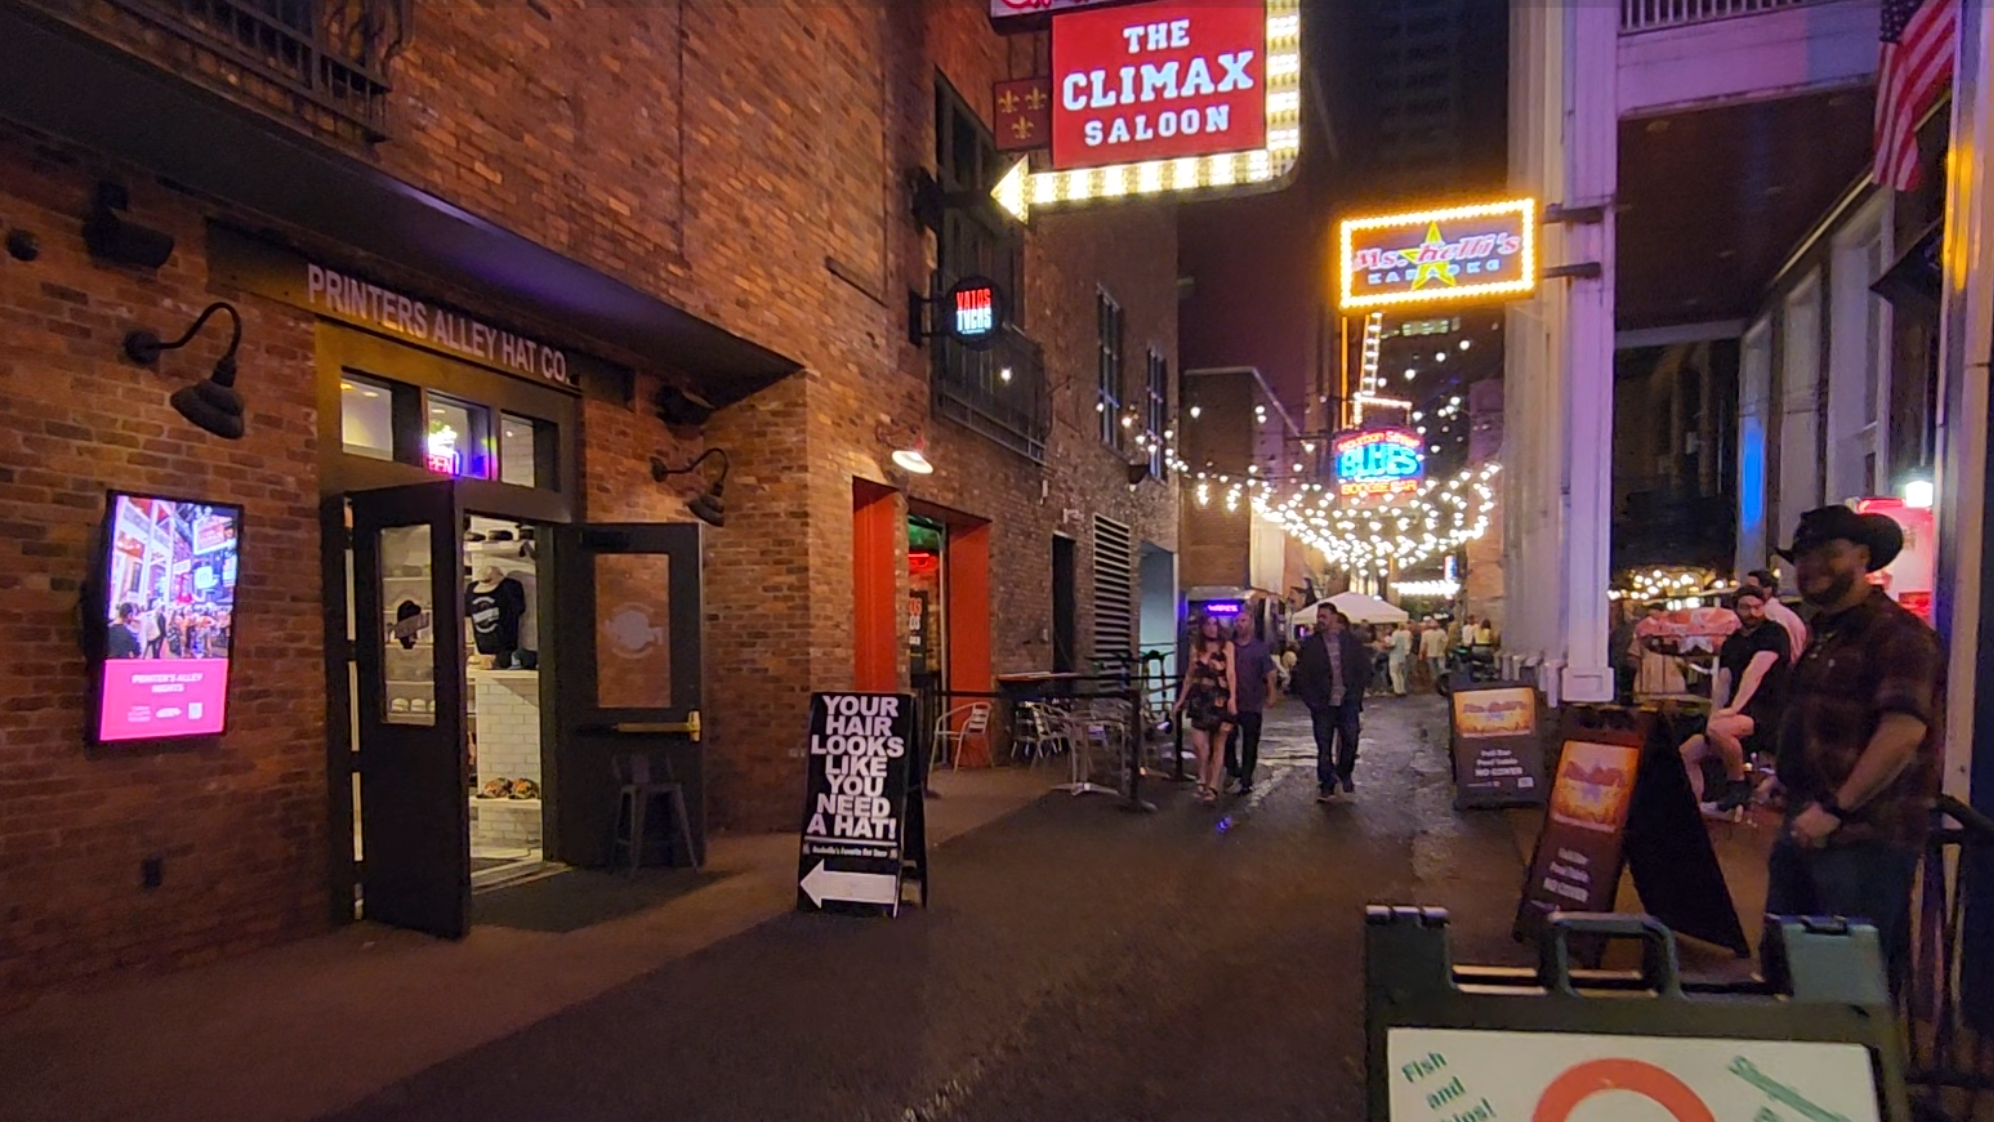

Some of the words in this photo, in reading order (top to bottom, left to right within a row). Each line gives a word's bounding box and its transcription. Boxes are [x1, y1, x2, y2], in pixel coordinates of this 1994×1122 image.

[1123, 19, 1190, 53] THE
[1063, 50, 1254, 111] CLIMAX
[1084, 104, 1229, 146] SALOON
[1367, 259, 1500, 285] KARAOKE
[308, 263, 428, 339] PRINTERS
[433, 308, 498, 361] ALLEY
[502, 331, 537, 373] HAT
[541, 346, 571, 386] CO.
[1340, 442, 1417, 477] BLUES
[822, 695, 899, 717] YOUR
[825, 714, 892, 737] HAIR
[811, 734, 905, 758] LOOKS
[825, 754, 888, 778] LIKE
[825, 774, 884, 797] YOU
[817, 793, 891, 817] NEED
[806, 813, 827, 835] A
[833, 817, 897, 839] HAT!
[1402, 1051, 1447, 1084] Fish
[1426, 1075, 1465, 1110] and
